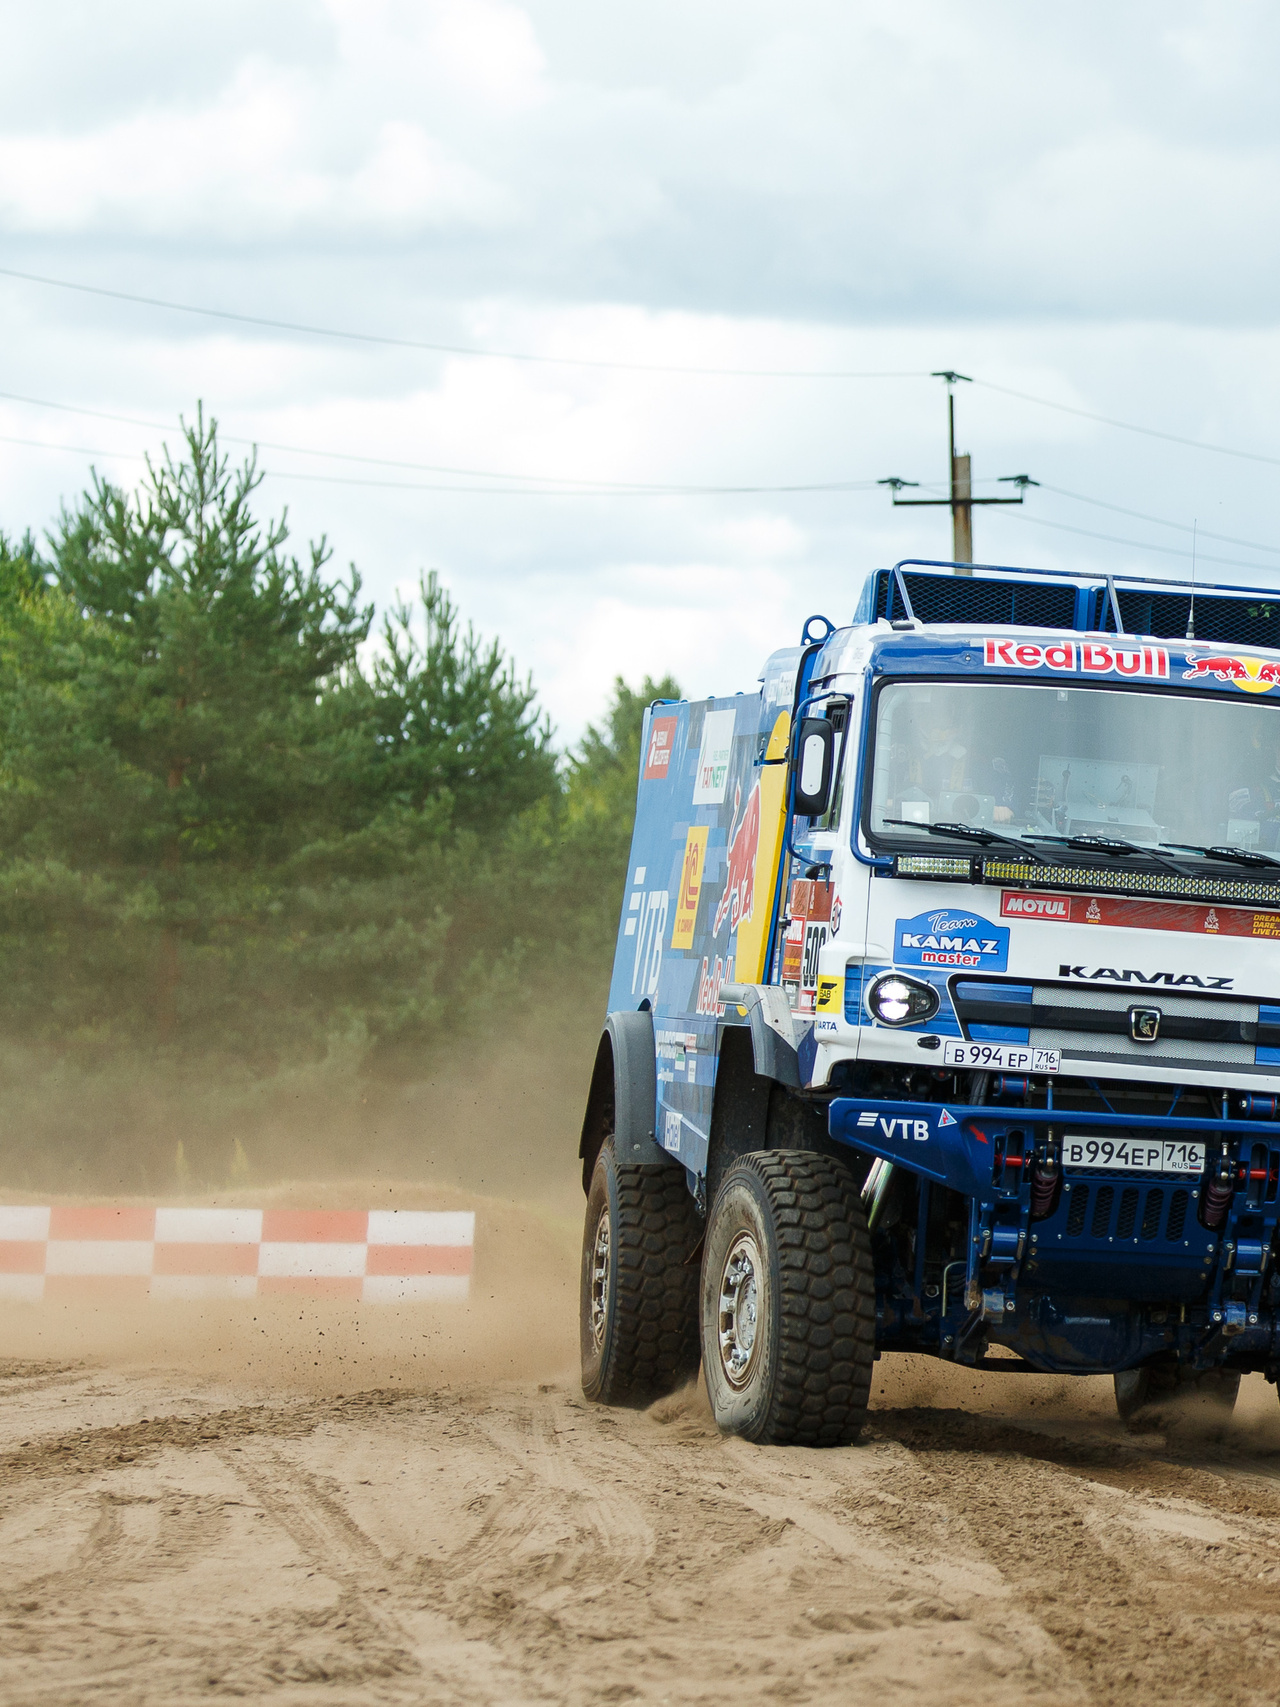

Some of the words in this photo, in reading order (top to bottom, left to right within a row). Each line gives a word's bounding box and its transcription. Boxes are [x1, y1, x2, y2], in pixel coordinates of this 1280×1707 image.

[985, 638, 1075, 670] Red
[1082, 643, 1169, 677] Bull
[1006, 897, 1067, 916] MOTUL
[928, 911, 977, 932] Team
[1252, 928, 1270, 936] LIVE
[631, 890, 669, 995] VTB
[902, 933, 999, 954] KAMAZ
[922, 952, 980, 966] master
[1058, 964, 1235, 990] KAMAZ
[1036, 1051, 1056, 1064] 716
[879, 1117, 930, 1141] VTB
[1165, 1143, 1199, 1162] 716
[1171, 1161, 1189, 1170] RUS
